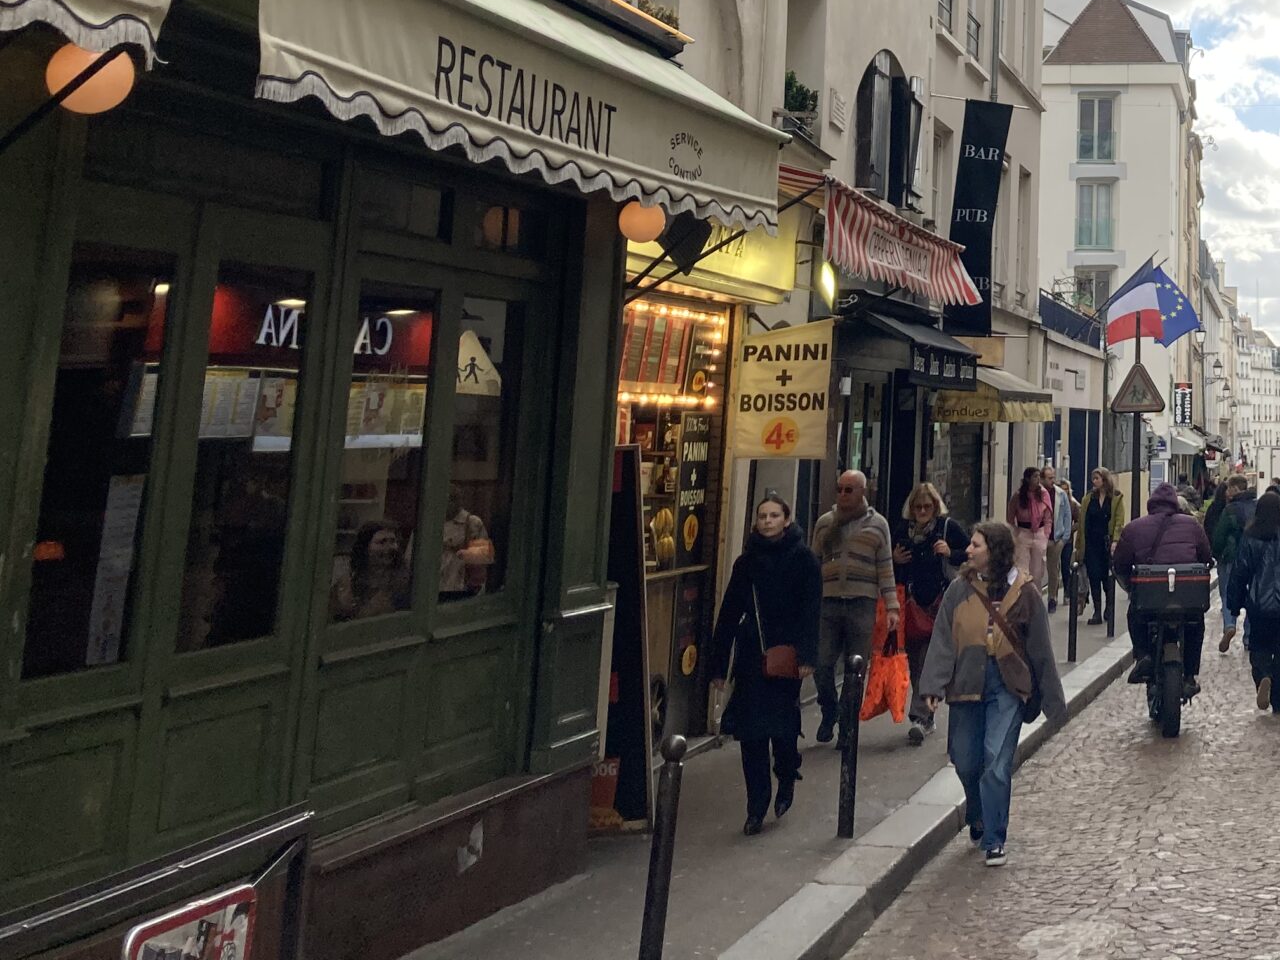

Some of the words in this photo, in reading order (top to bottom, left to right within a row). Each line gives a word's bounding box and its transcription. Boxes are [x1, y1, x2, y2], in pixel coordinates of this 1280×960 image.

[434, 36, 617, 157] RESTAURANT
[670, 131, 703, 159] SERVICE
[963, 144, 1000, 161] BAR
[668, 156, 703, 181] CONTINU
[955, 208, 988, 223] PUB
[743, 343, 828, 362] PANINI
[775, 369, 792, 387] +
[739, 392, 825, 412] BOISSON
[936, 405, 990, 417] Fondues
[764, 422, 795, 450] 4€
[682, 441, 709, 462] PANINI
[680, 489, 705, 507] BOISSON
